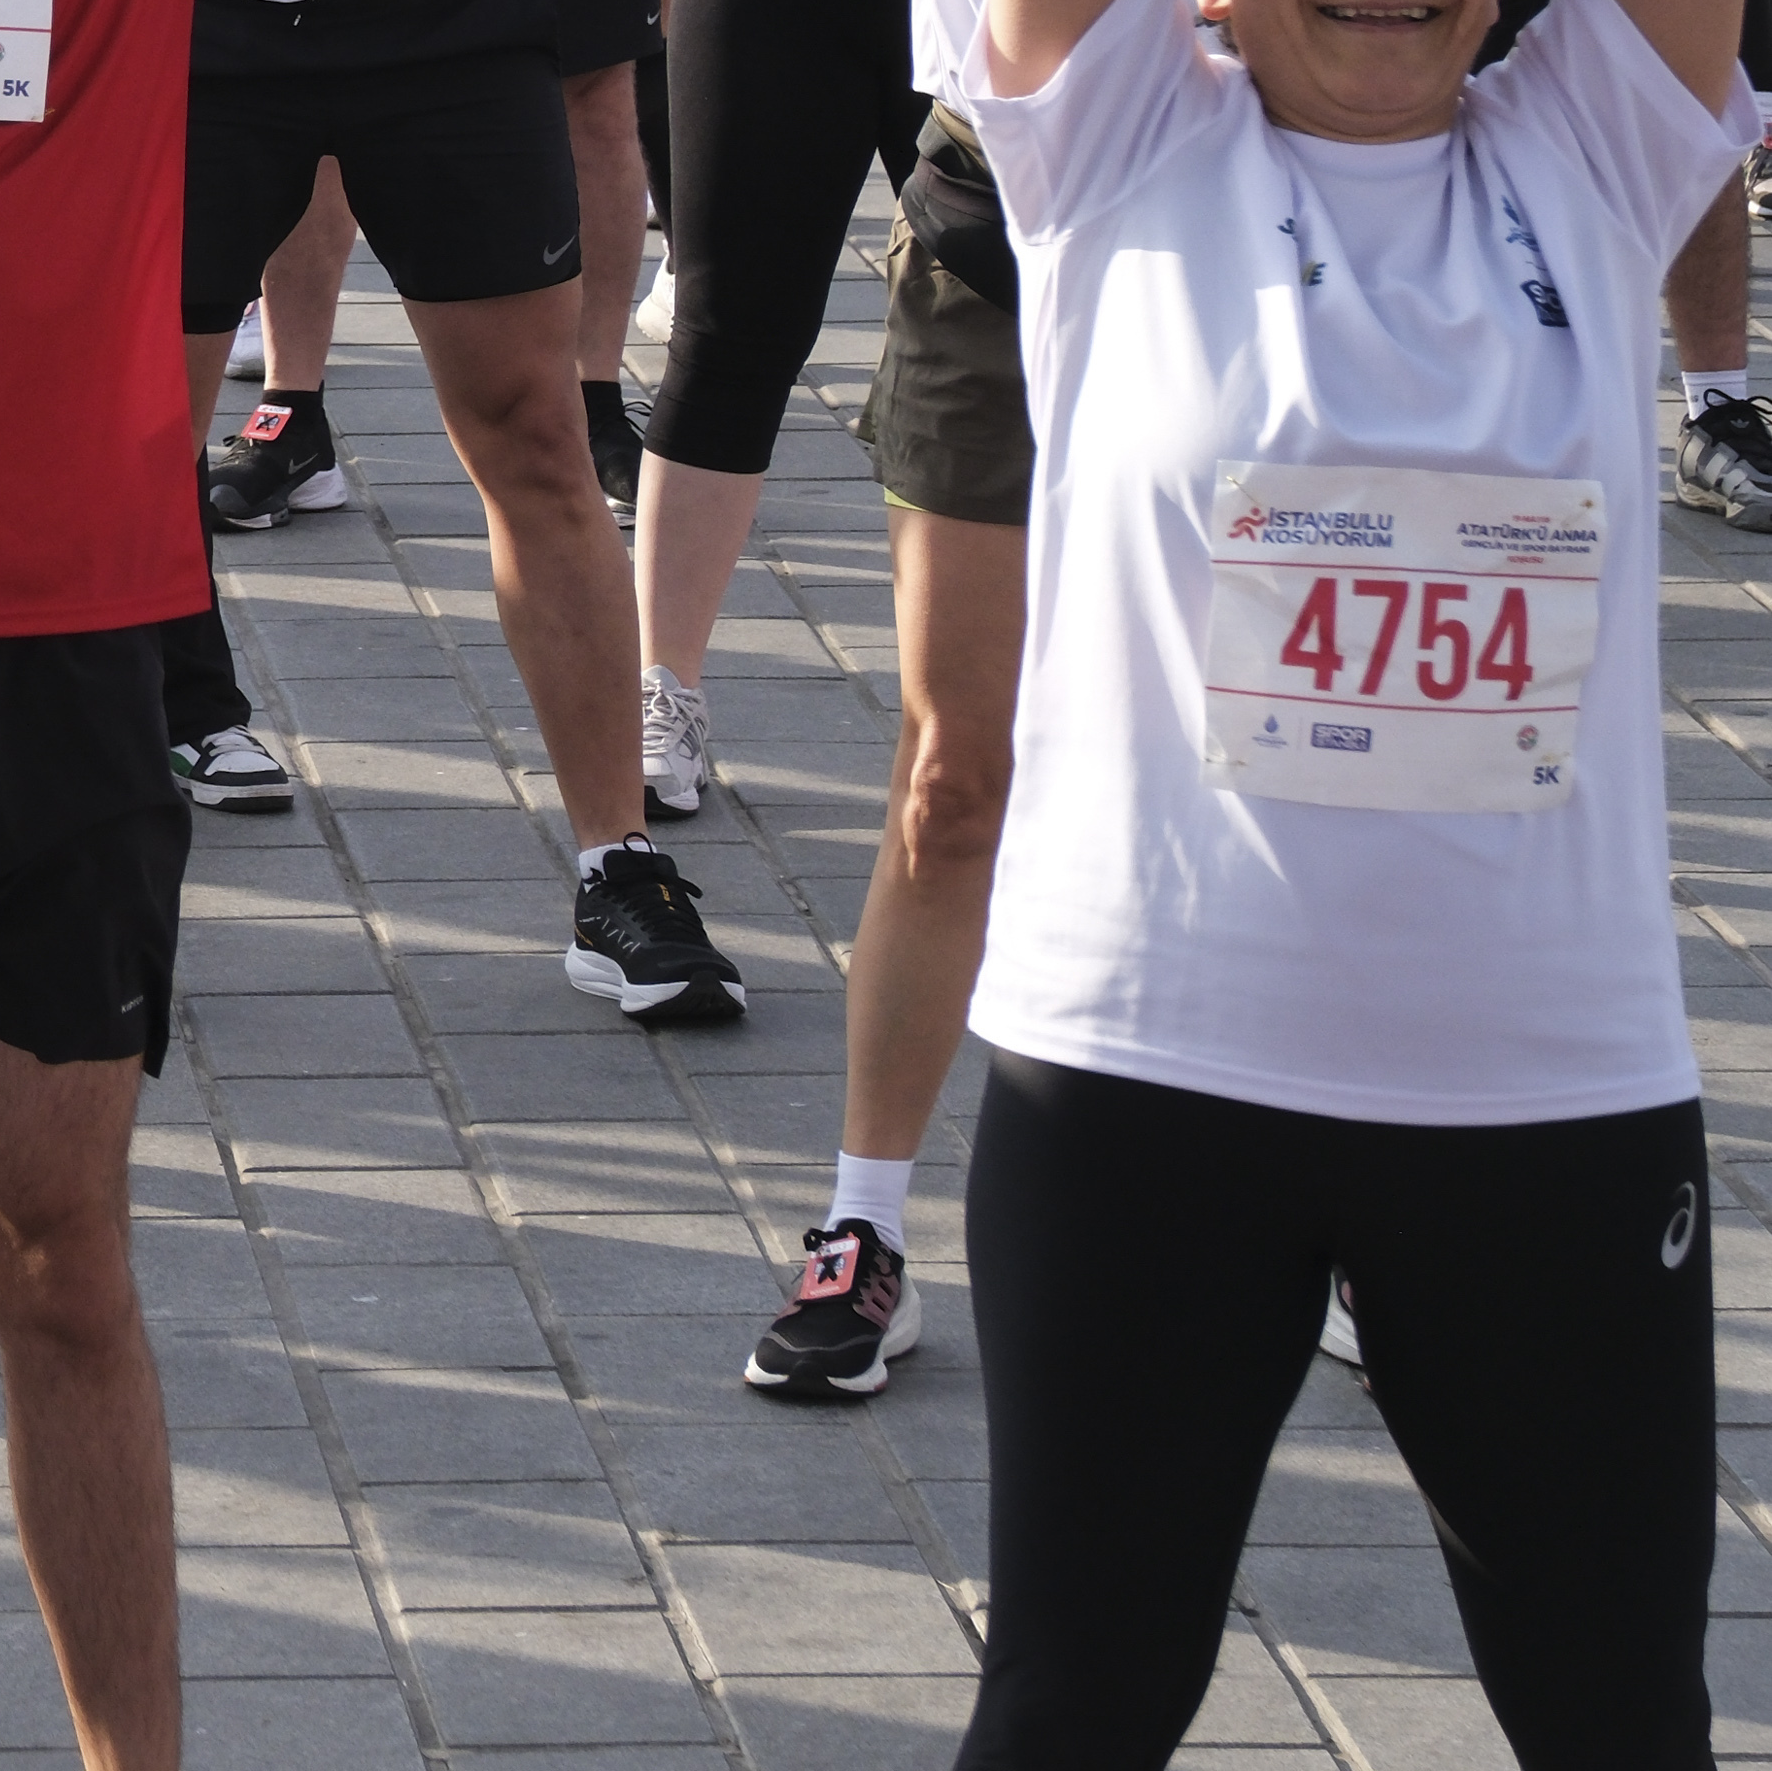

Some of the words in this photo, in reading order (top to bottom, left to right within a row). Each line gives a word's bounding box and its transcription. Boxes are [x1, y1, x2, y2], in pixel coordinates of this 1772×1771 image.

[2, 79, 30, 98] 5K
[1268, 507, 1394, 532] İSTANBULU
[1456, 522, 1548, 542] ATATÜRK'Ü
[1550, 528, 1598, 543] ANMA
[1279, 576, 1535, 702] 4754
[1314, 725, 1369, 743] SPOR
[1533, 766, 1561, 786] 5K
